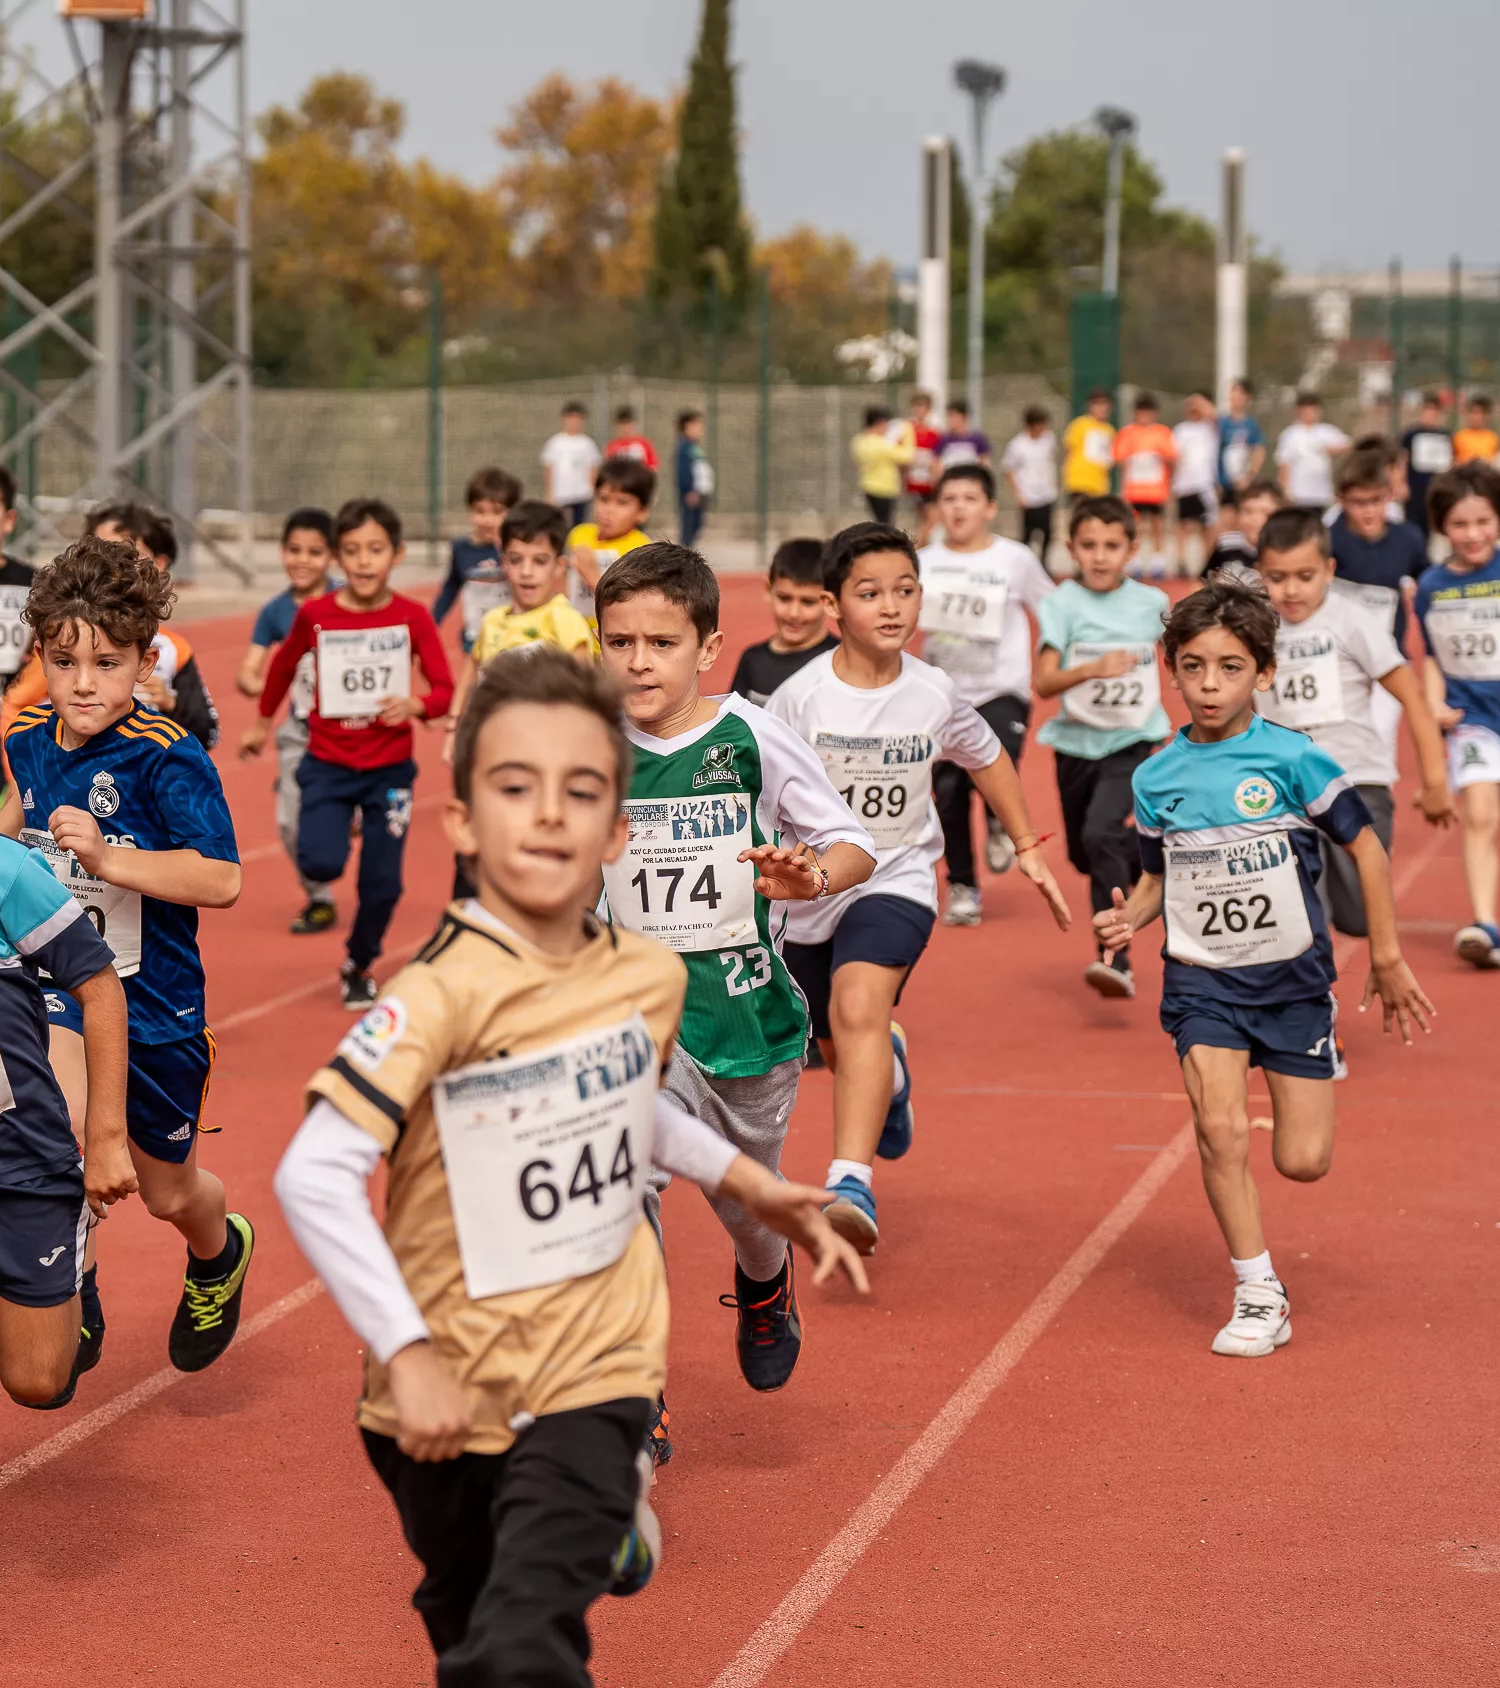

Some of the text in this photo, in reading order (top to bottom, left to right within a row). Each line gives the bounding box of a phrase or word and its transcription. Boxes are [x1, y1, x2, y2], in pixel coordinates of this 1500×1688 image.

[941, 592, 986, 618] 770
[343, 665, 393, 693] 687
[1271, 674, 1317, 705] 148
[1092, 681, 1143, 706] 222
[660, 804, 669, 812] DE
[670, 800, 714, 820] 2024
[840, 783, 907, 818] 189
[628, 813, 669, 821] POPULARES
[654, 847, 677, 855] CIUDAD
[688, 844, 713, 852] LUCENA
[664, 855, 697, 863] IGUALDAD
[1223, 842, 1261, 861] 2024
[81, 885, 104, 894] LUCENA
[631, 864, 722, 913] 174
[679, 922, 713, 930] PACHECO
[1197, 893, 1277, 937] 262
[719, 946, 772, 996] 23
[519, 1127, 635, 1222] 644
